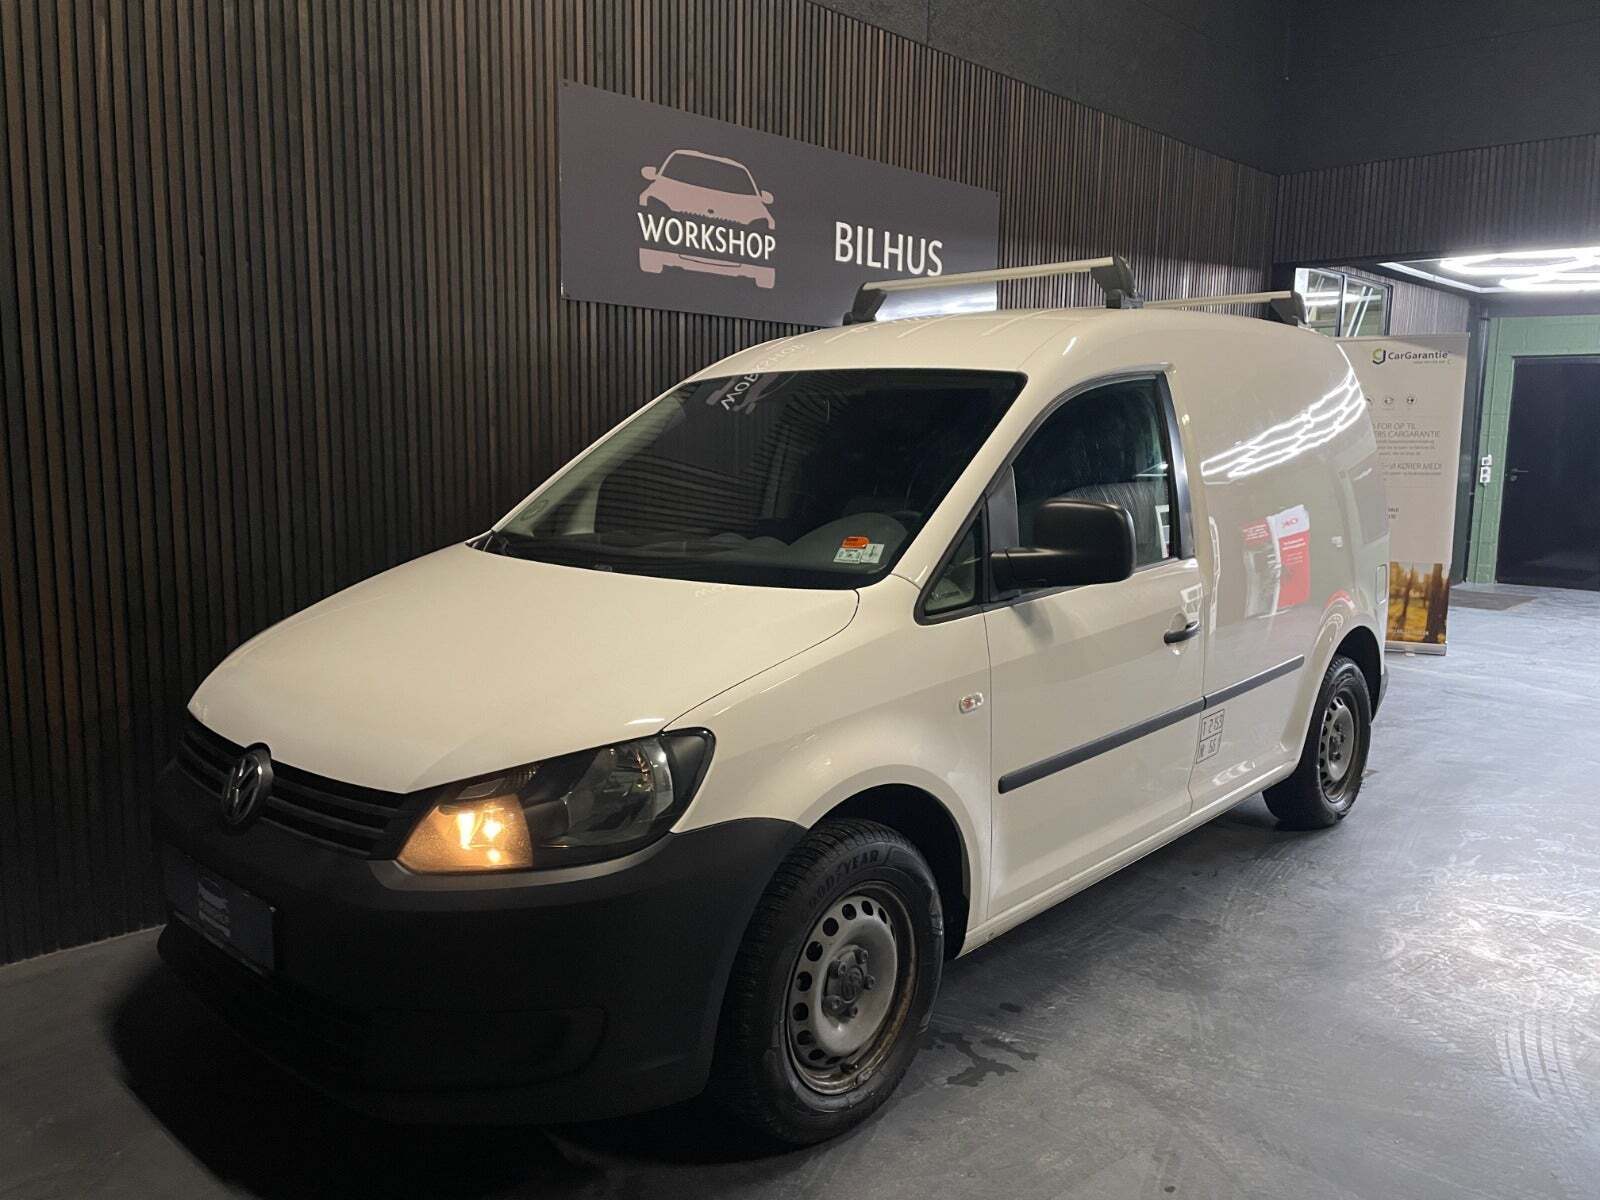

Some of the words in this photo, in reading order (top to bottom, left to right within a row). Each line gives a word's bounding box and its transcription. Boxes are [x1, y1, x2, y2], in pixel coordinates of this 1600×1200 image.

[637, 212, 776, 261] WORKSHOP
[835, 221, 943, 277] BILHUS
[1388, 351, 1448, 360] CarGarantie
